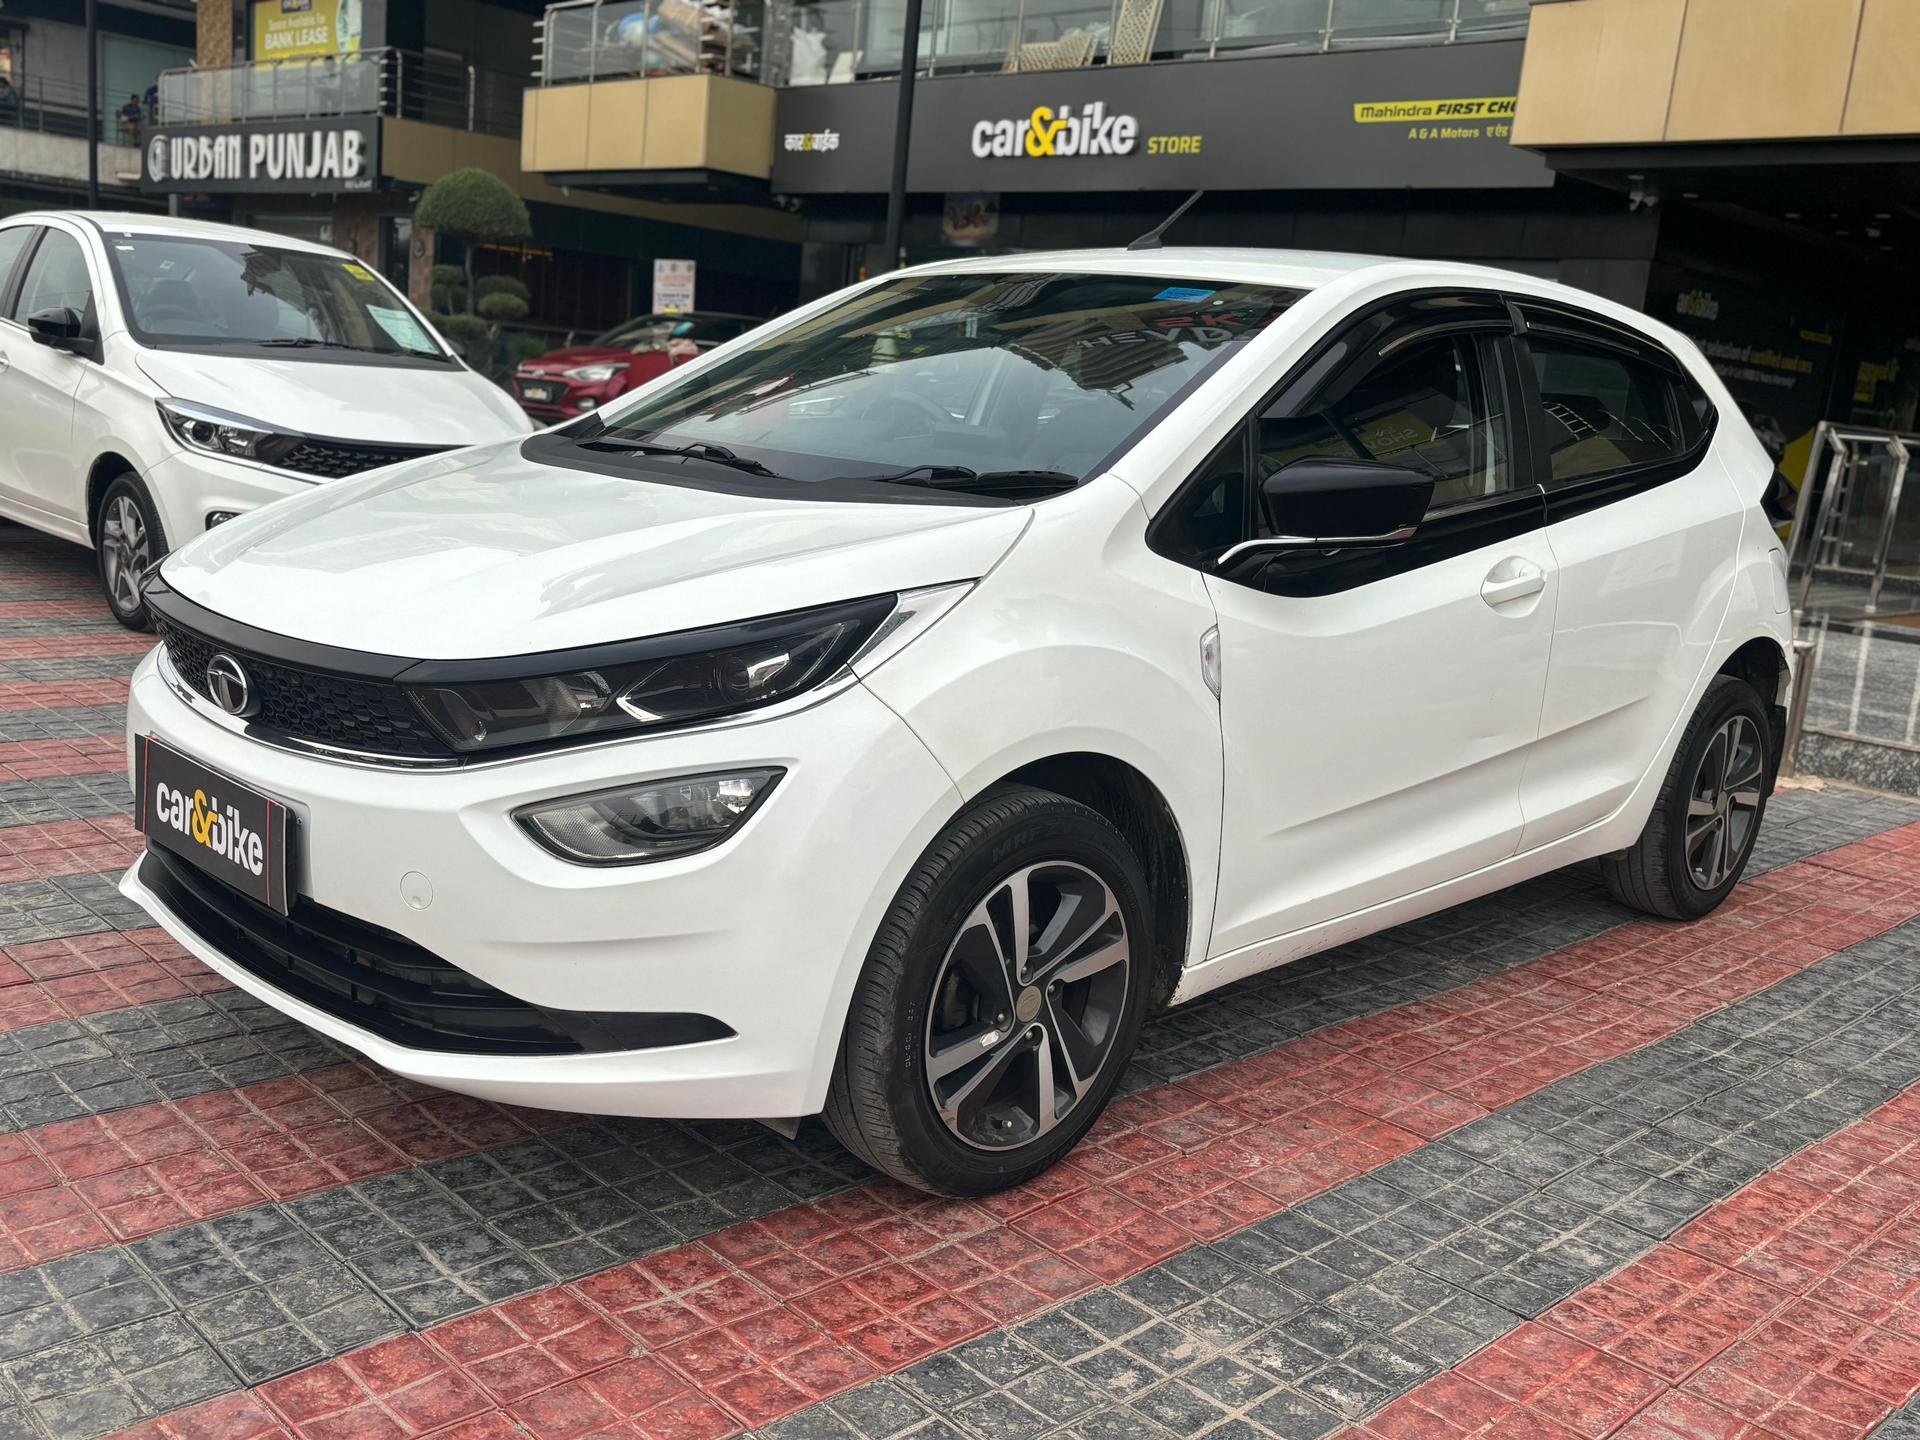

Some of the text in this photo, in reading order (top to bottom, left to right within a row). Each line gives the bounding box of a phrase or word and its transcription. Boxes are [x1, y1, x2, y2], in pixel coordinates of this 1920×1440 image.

[264, 26, 328, 50] BANK LEASE
[1360, 104, 1432, 119] Mahindra
[1436, 102, 1485, 116] FIRST
[971, 101, 1202, 158] car&bike STORE
[1408, 126, 1479, 140] A & A Motors
[170, 130, 364, 180] URBAN PUNJAB
[156, 782, 263, 876] car&bike
